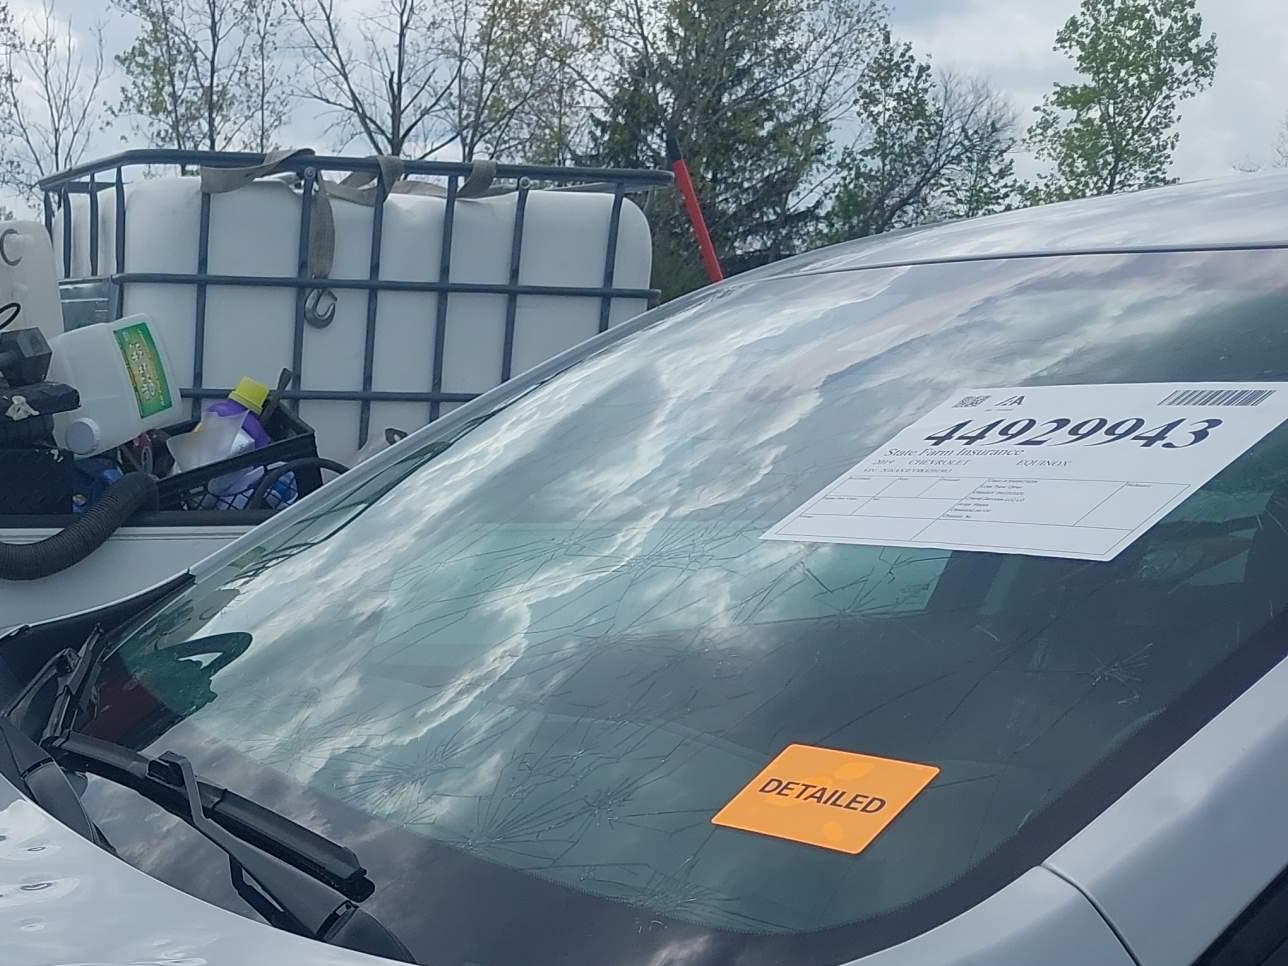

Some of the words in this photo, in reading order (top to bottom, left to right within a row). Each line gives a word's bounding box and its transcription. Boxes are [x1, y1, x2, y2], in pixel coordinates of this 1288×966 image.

[924, 418, 1224, 449] 44929943
[884, 448, 918, 457] State
[918, 448, 954, 457] Farm
[956, 448, 1025, 457] Insurance
[759, 778, 886, 813] DETAILED
